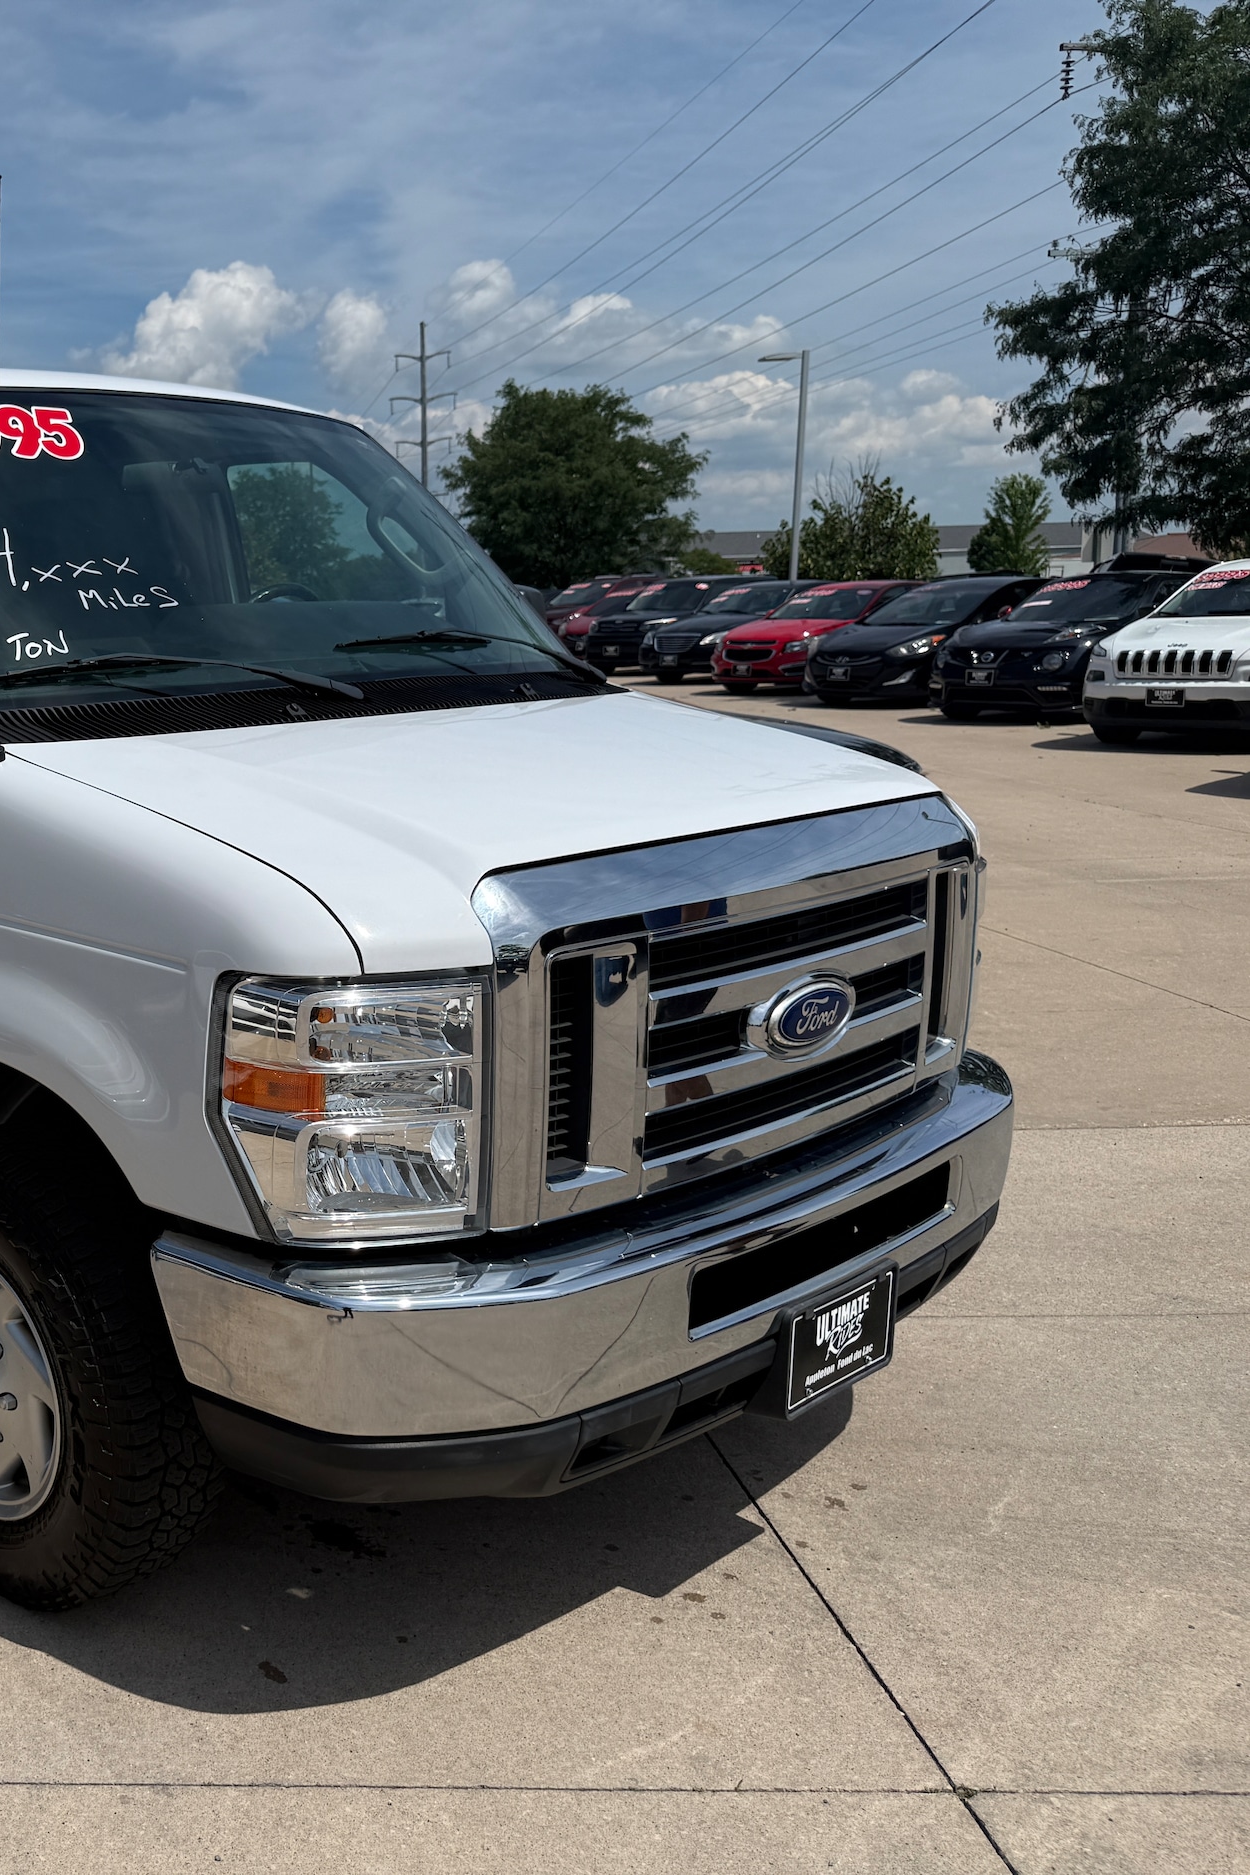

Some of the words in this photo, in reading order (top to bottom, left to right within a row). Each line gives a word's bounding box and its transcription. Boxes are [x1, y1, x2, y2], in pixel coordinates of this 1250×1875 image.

[796, 996, 840, 1035] Ford
[816, 1291, 870, 1347] ULTIMATE
[805, 1364, 835, 1387] Appleton
[837, 1353, 853, 1370] Fond
[862, 1343, 873, 1356] Lac
